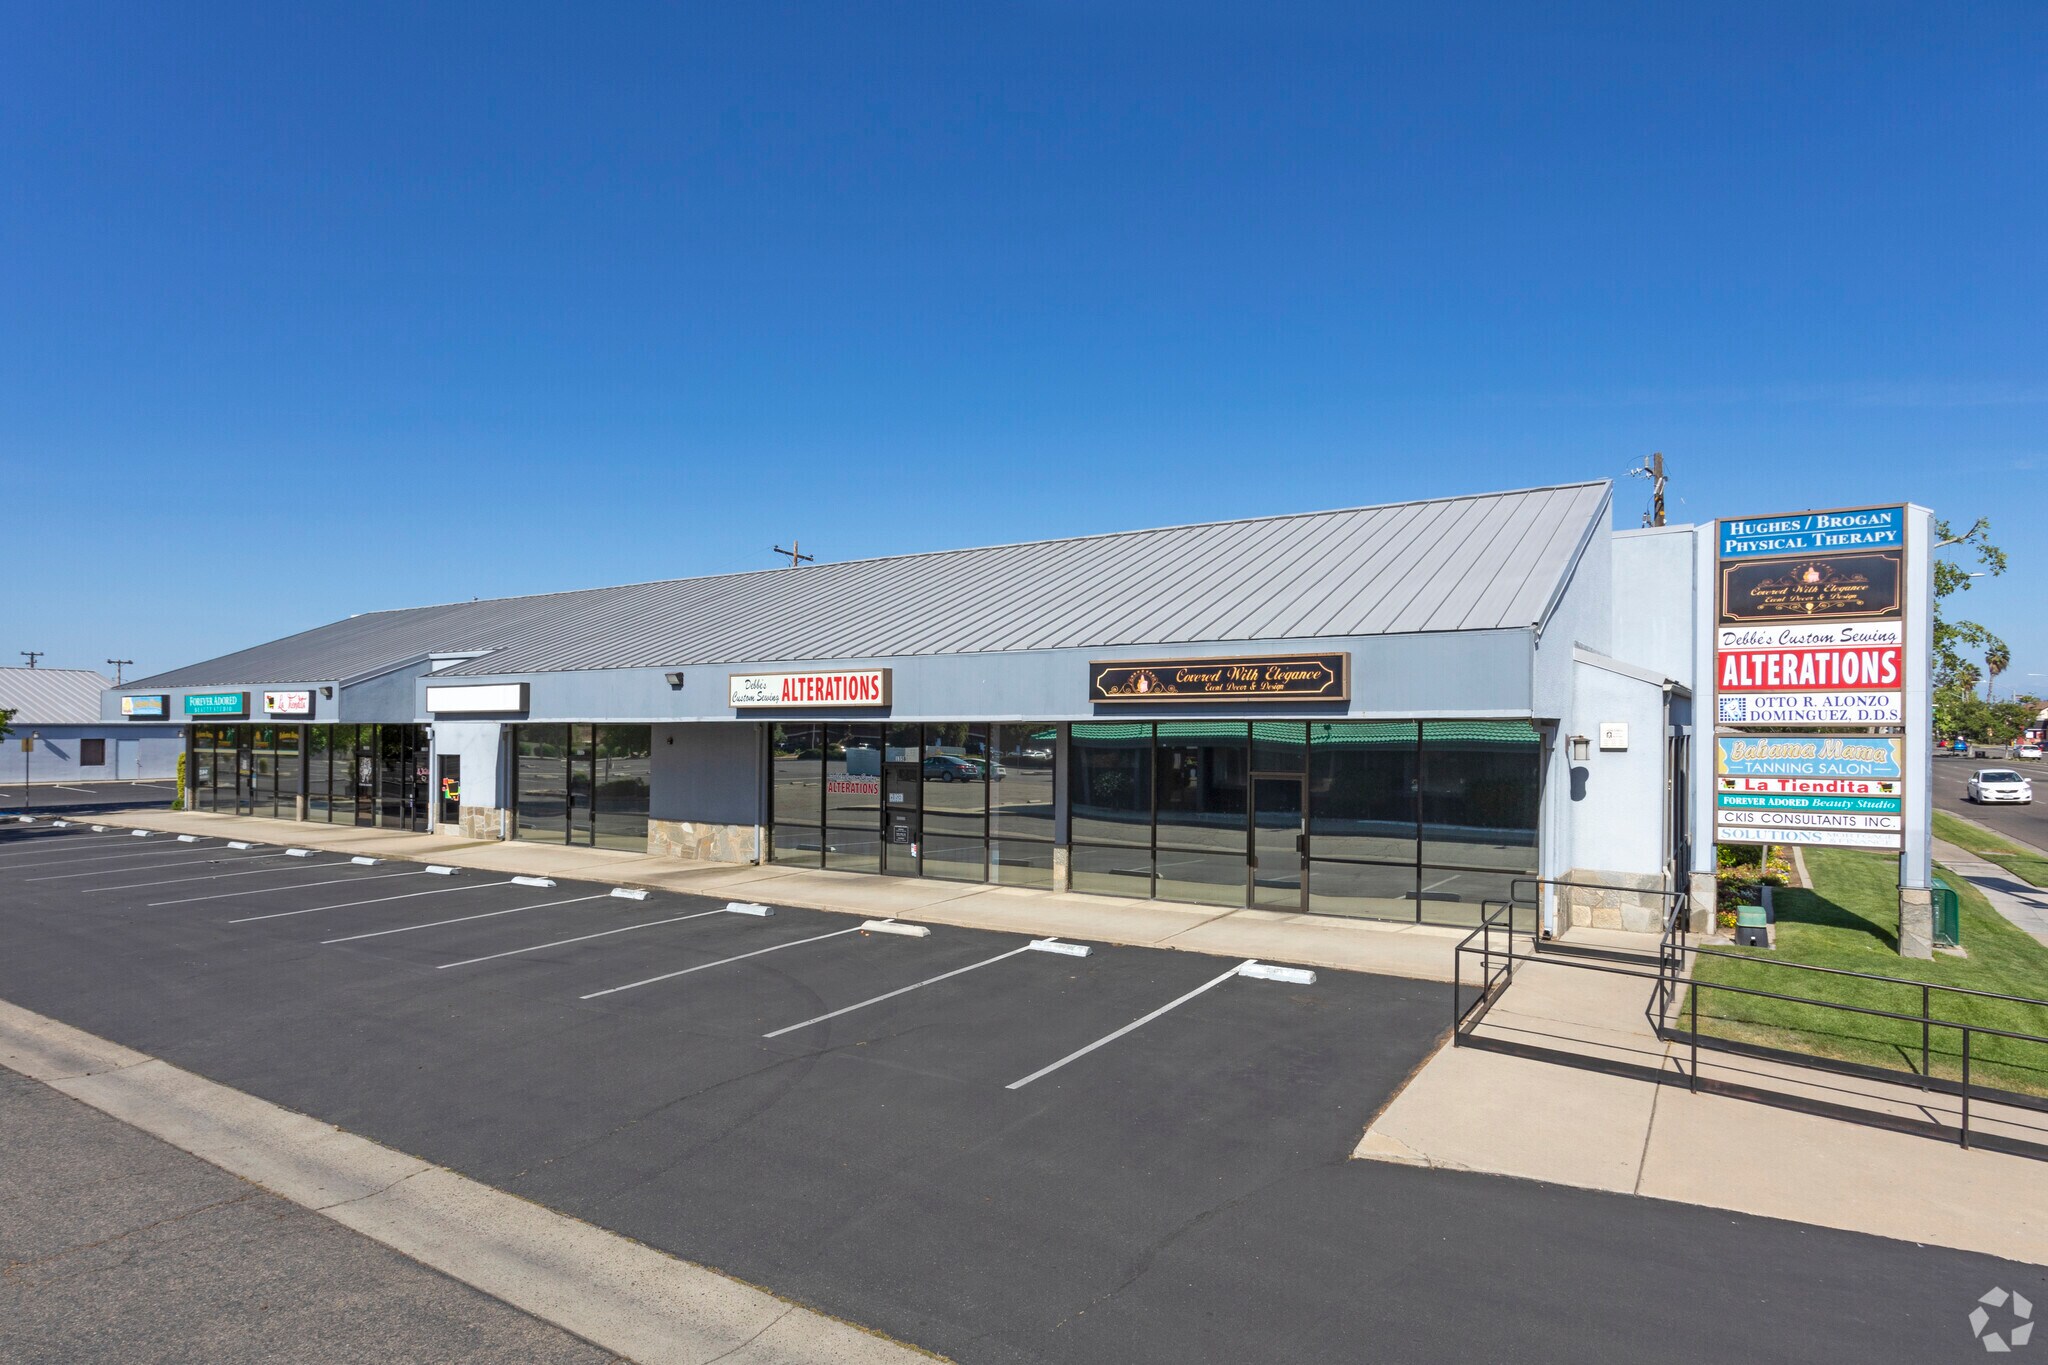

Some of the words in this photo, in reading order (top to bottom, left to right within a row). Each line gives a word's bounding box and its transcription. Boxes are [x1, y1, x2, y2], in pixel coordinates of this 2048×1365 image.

[1730, 519, 1800, 535] HUGHES
[1817, 513, 1892, 529] BROGAN
[1725, 537, 1807, 553] PHYSICAL
[1812, 530, 1897, 546] THERAPY
[1750, 587, 1788, 596] Covered
[1793, 585, 1818, 594] With
[1824, 584, 1869, 593] Elegance
[1830, 593, 1857, 601] Design
[1779, 630, 1835, 645] Custom
[1841, 628, 1898, 644] Sewing
[1722, 650, 1897, 686] ALTERATIONS
[1176, 668, 1221, 683] Covered
[1227, 667, 1258, 681] With
[1265, 666, 1321, 684] Elegance
[782, 675, 879, 701] ALTERATIONS
[1226, 682, 1247, 691] Decor
[1250, 682, 1256, 690] &
[1260, 681, 1284, 692] Design
[190, 697, 212, 706] FOREVER
[214, 696, 237, 705] ADORED
[732, 691, 755, 702] Custom
[757, 691, 779, 703] Sewing
[1755, 697, 1797, 708] OTTO
[1804, 697, 1816, 707] R.
[1824, 696, 1889, 707] ALONZO
[1751, 710, 1852, 721] DOMINGUEZ,
[1858, 709, 1901, 720] D.D.S.
[1731, 740, 1815, 761] Bahama
[1818, 739, 1887, 763] Mama
[1745, 762, 1813, 773] TANNING
[1819, 763, 1871, 774] SALON
[828, 782, 878, 794] ALTERATIONS
[1745, 779, 1768, 791] La
[1778, 780, 1869, 793] Tiendita
[1724, 797, 1765, 806] FOREVER
[1768, 798, 1809, 806] ADORED
[1812, 799, 1853, 809] Beauty
[1856, 800, 1895, 809] Studio
[1724, 813, 1754, 822] CKIS
[1761, 813, 1856, 826] CONSULTANTS
[1865, 817, 1896, 827] INC.
[1721, 829, 1822, 841] SOLUTIONS
